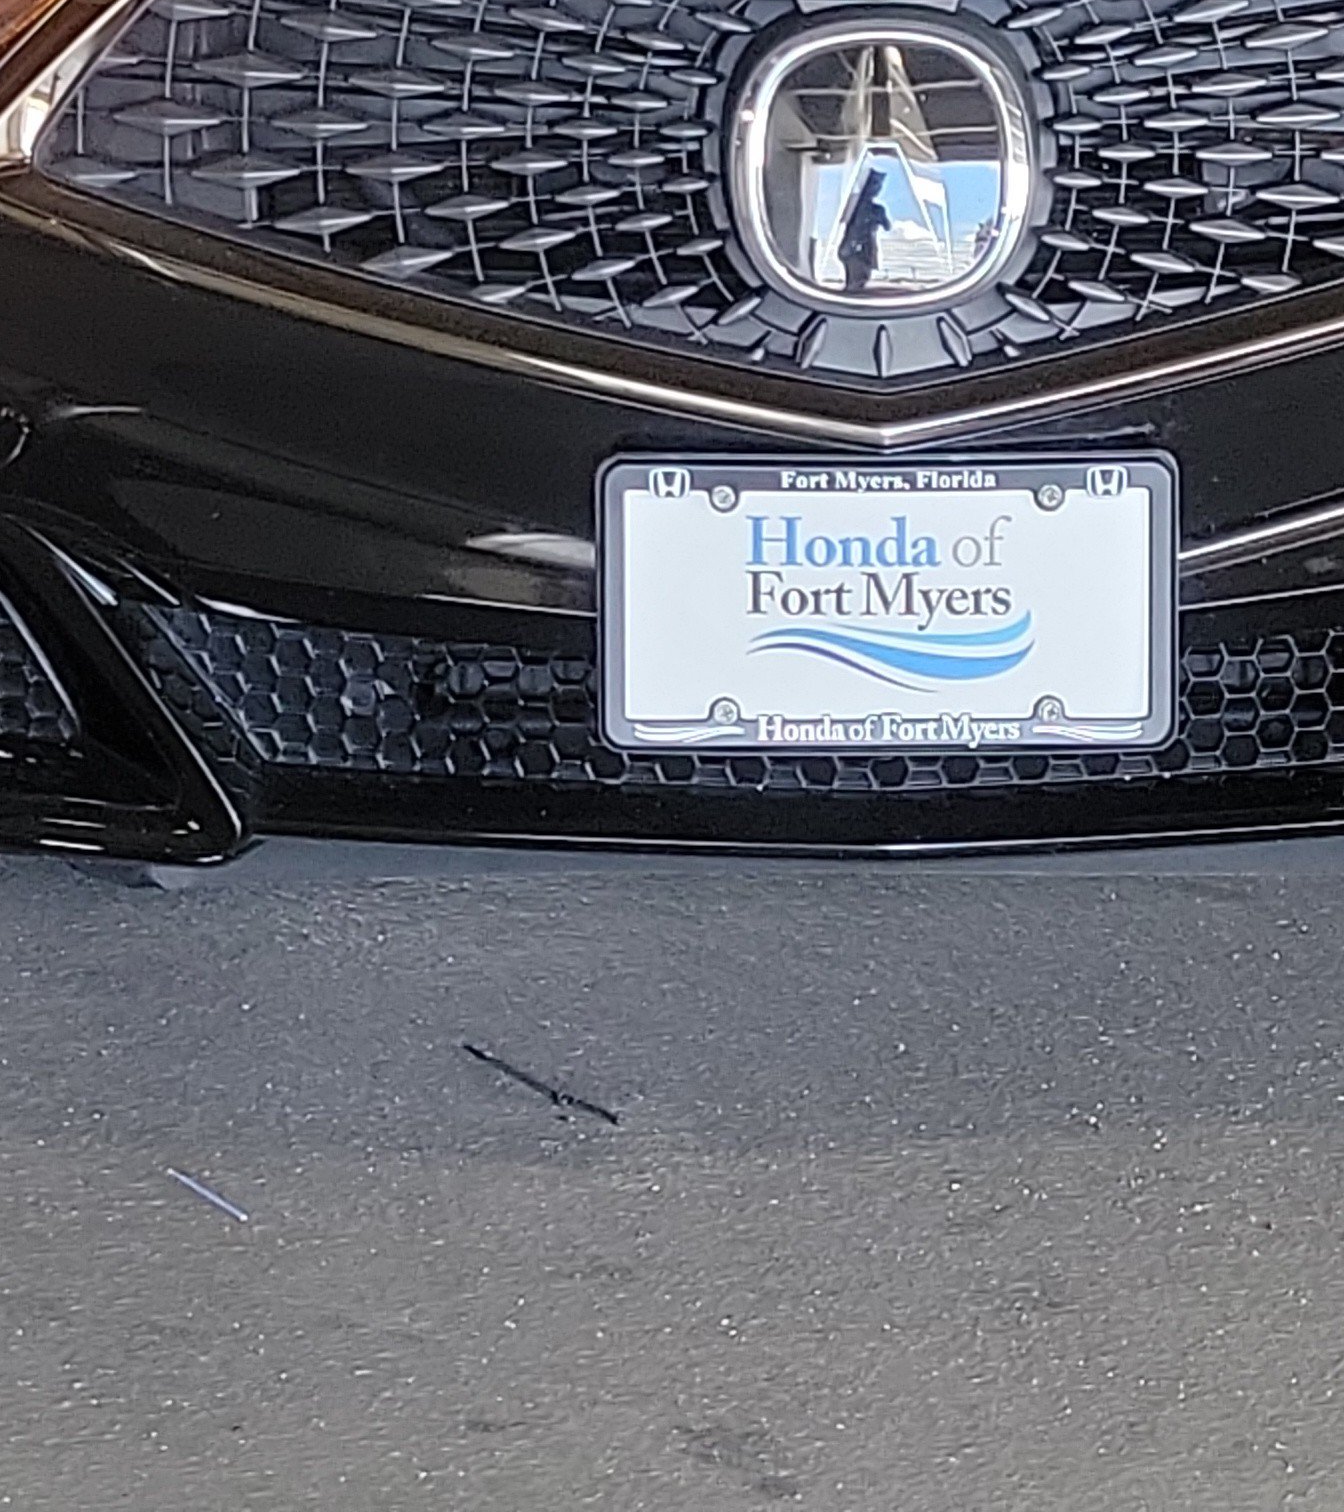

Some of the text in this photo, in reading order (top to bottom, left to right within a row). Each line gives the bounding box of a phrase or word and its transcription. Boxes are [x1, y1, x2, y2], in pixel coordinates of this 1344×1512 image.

[780, 470, 829, 489] Fort
[916, 469, 997, 488] Florida
[745, 515, 1013, 567] Honda of
[745, 570, 1013, 631] Fort Myers
[757, 713, 1021, 748] Honda of Fort Myers
